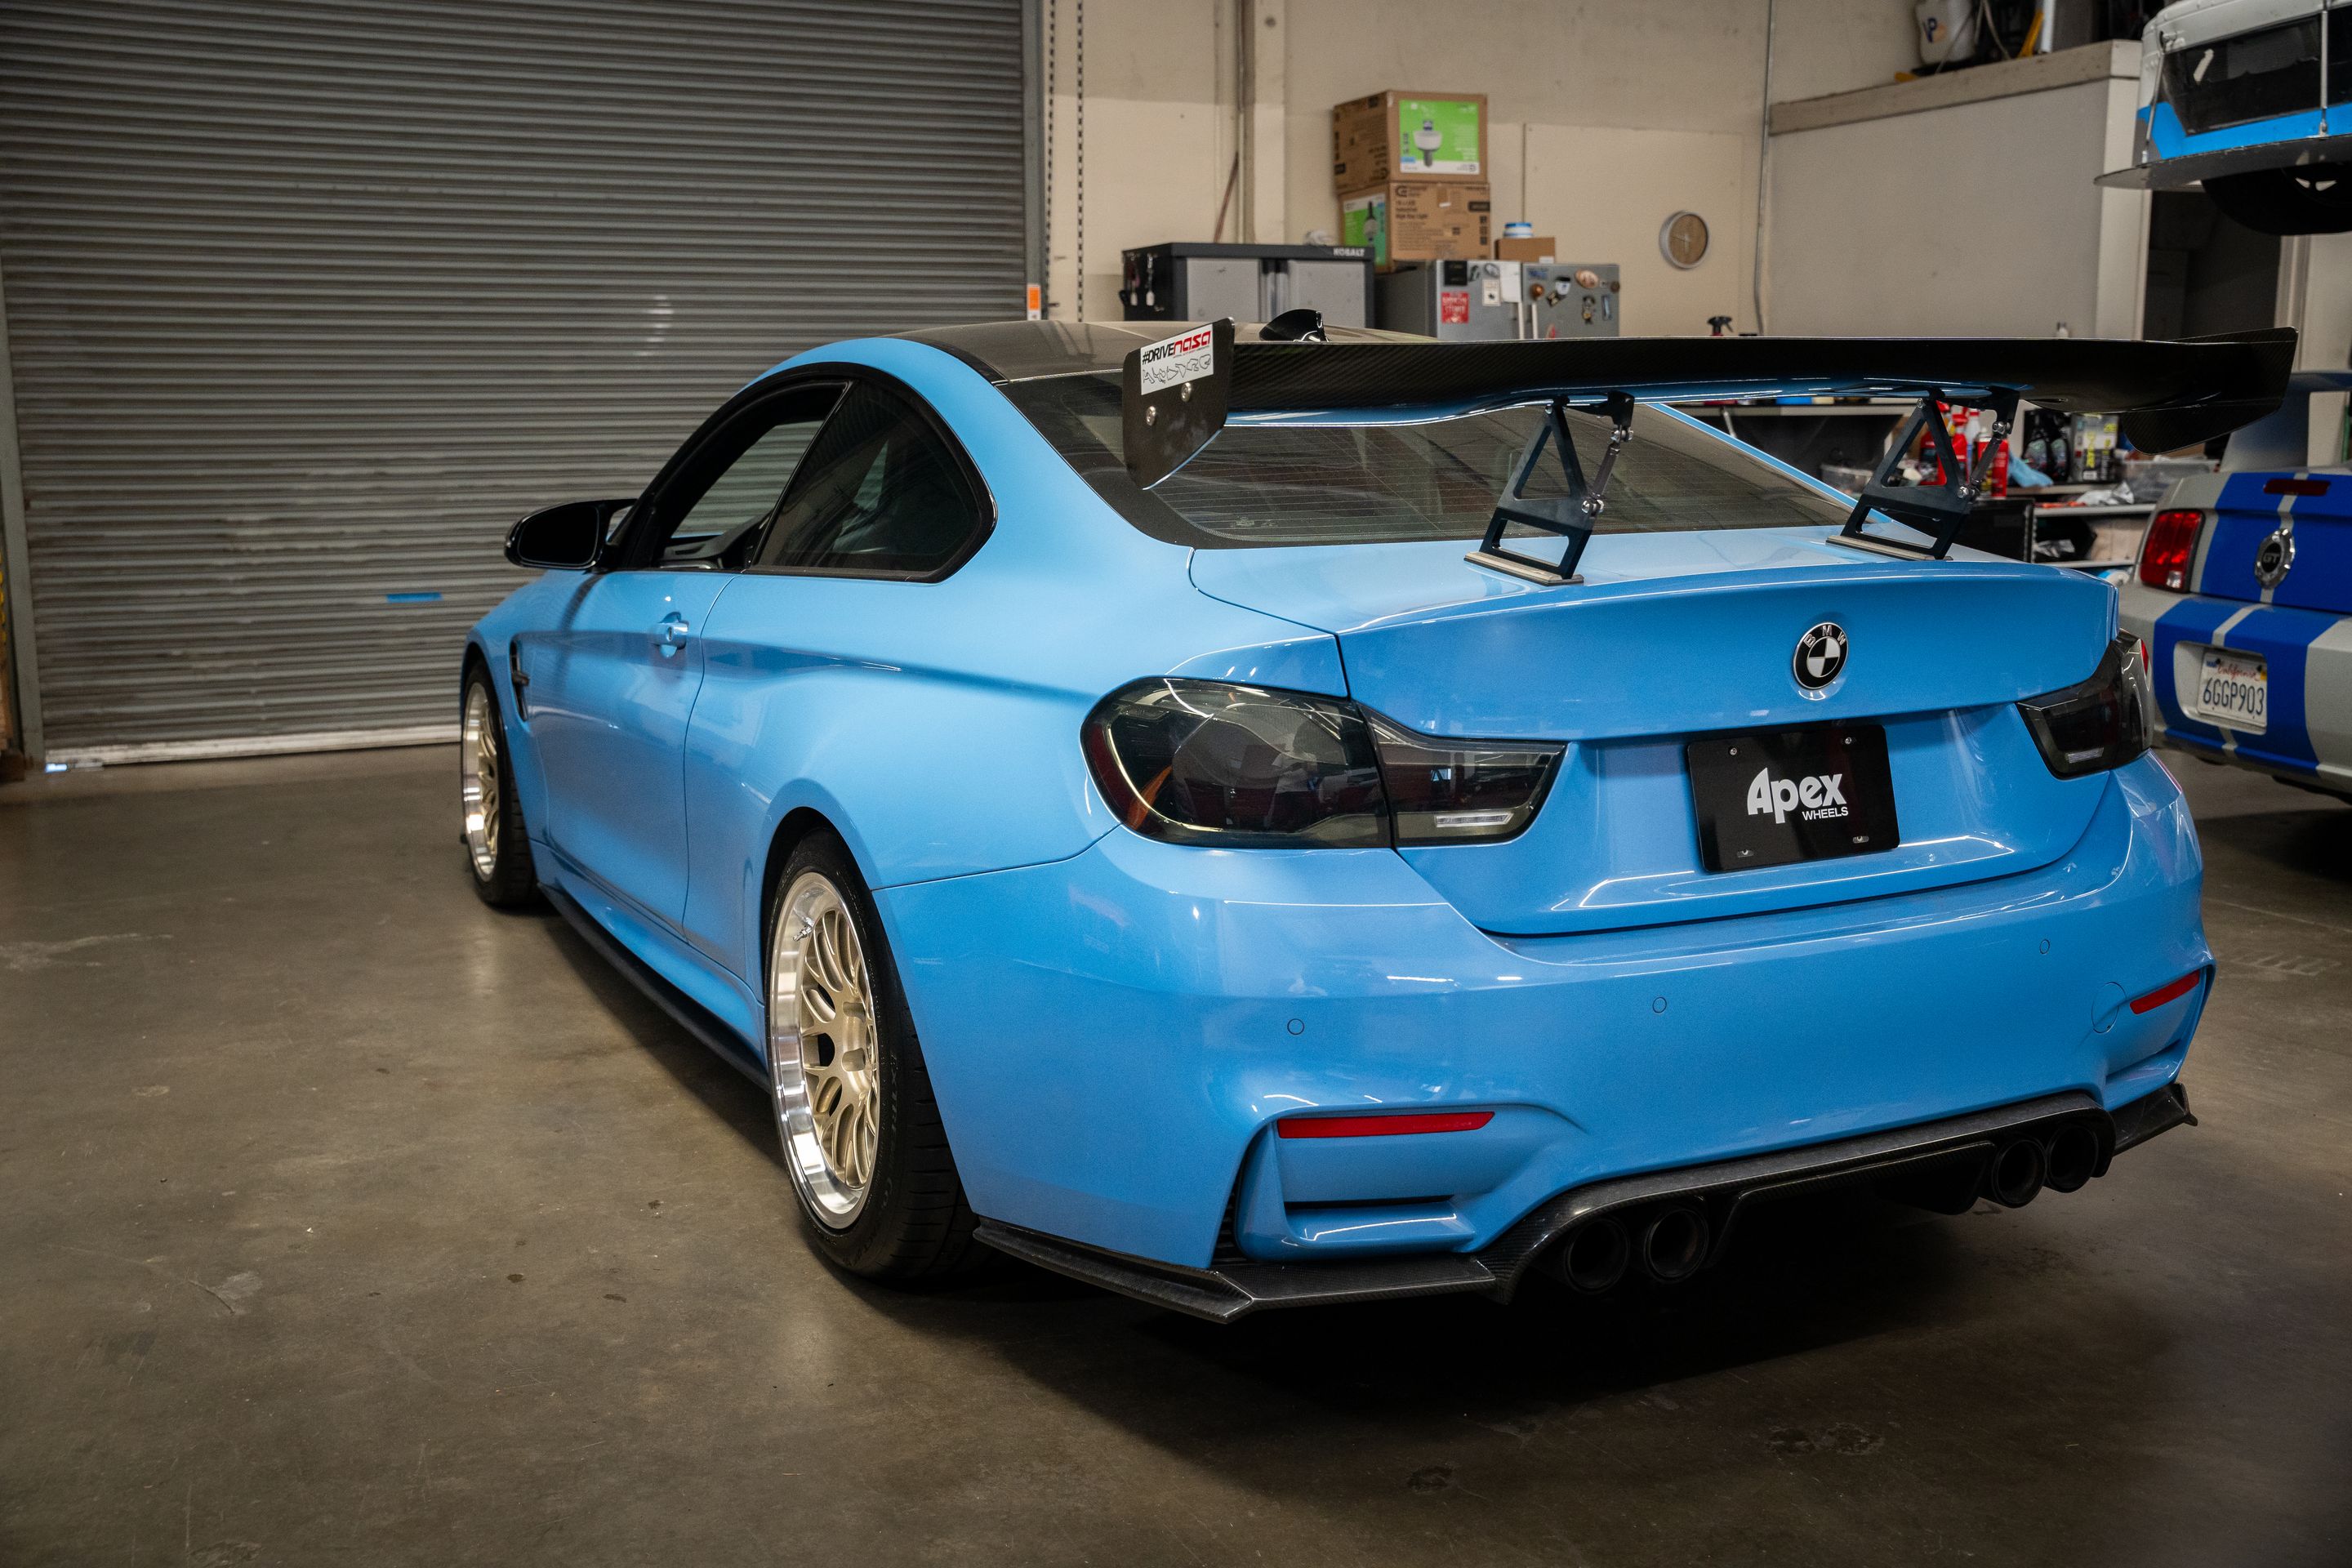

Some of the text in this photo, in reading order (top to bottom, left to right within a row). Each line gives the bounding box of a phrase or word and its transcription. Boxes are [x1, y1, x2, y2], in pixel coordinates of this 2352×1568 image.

[2263, 552, 2280, 563] GT
[1803, 625, 1846, 648] BMW
[2203, 677, 2265, 715] 6GGP903
[1747, 767, 1847, 824] Apex
[1802, 806, 1849, 821] WHEELS
